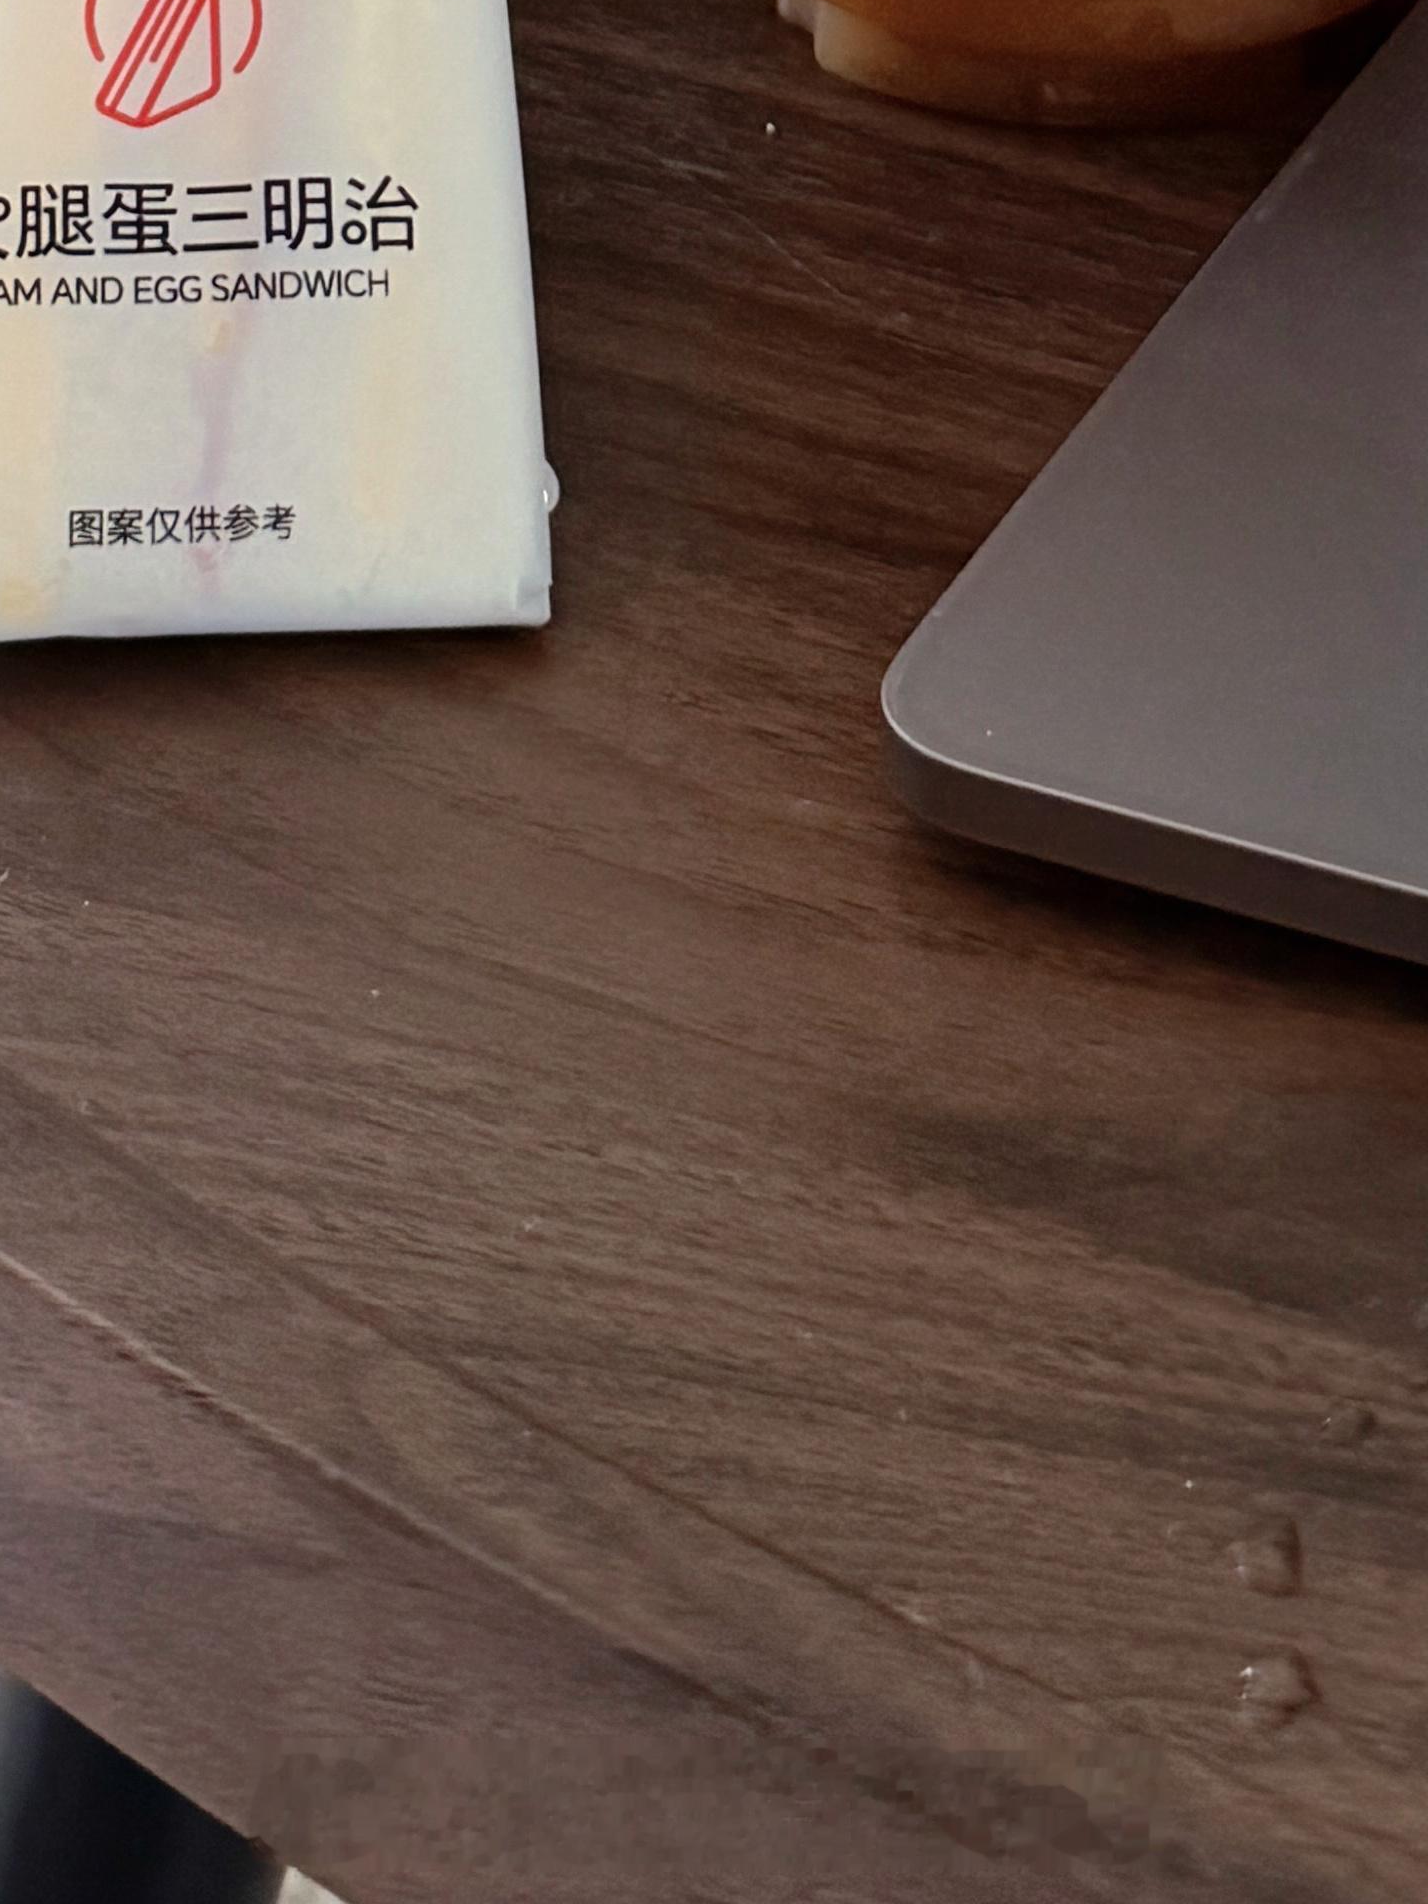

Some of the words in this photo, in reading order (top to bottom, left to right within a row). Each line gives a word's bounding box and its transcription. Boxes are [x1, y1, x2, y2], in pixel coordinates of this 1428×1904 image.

[51, 276, 124, 305] AND
[133, 275, 203, 305] EGG
[211, 269, 389, 303] SANDWICH
[68, 503, 296, 547] 图案仅供参考
